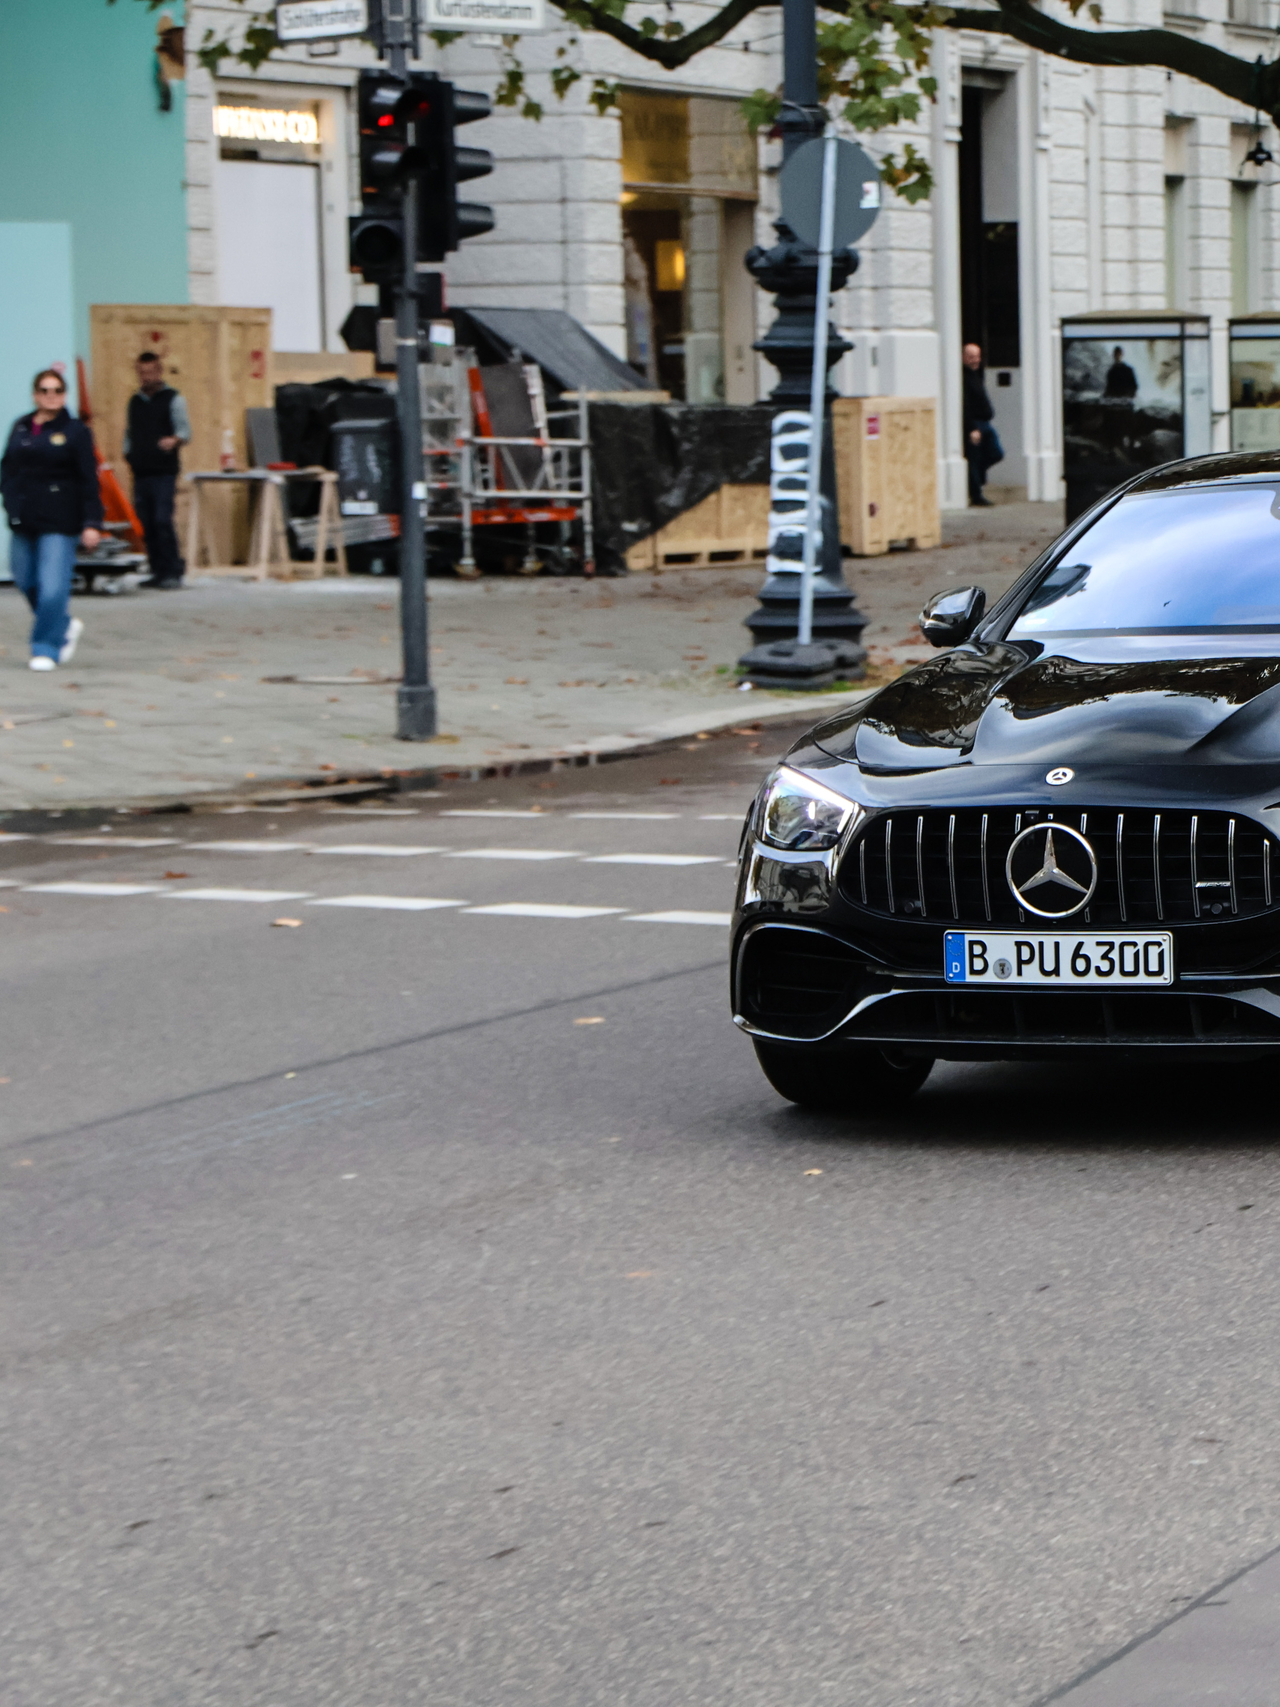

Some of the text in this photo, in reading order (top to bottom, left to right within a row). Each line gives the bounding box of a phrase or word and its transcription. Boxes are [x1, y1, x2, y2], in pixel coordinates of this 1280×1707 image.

[952, 961, 961, 973] D
[968, 939, 1165, 978] B PU 6300
